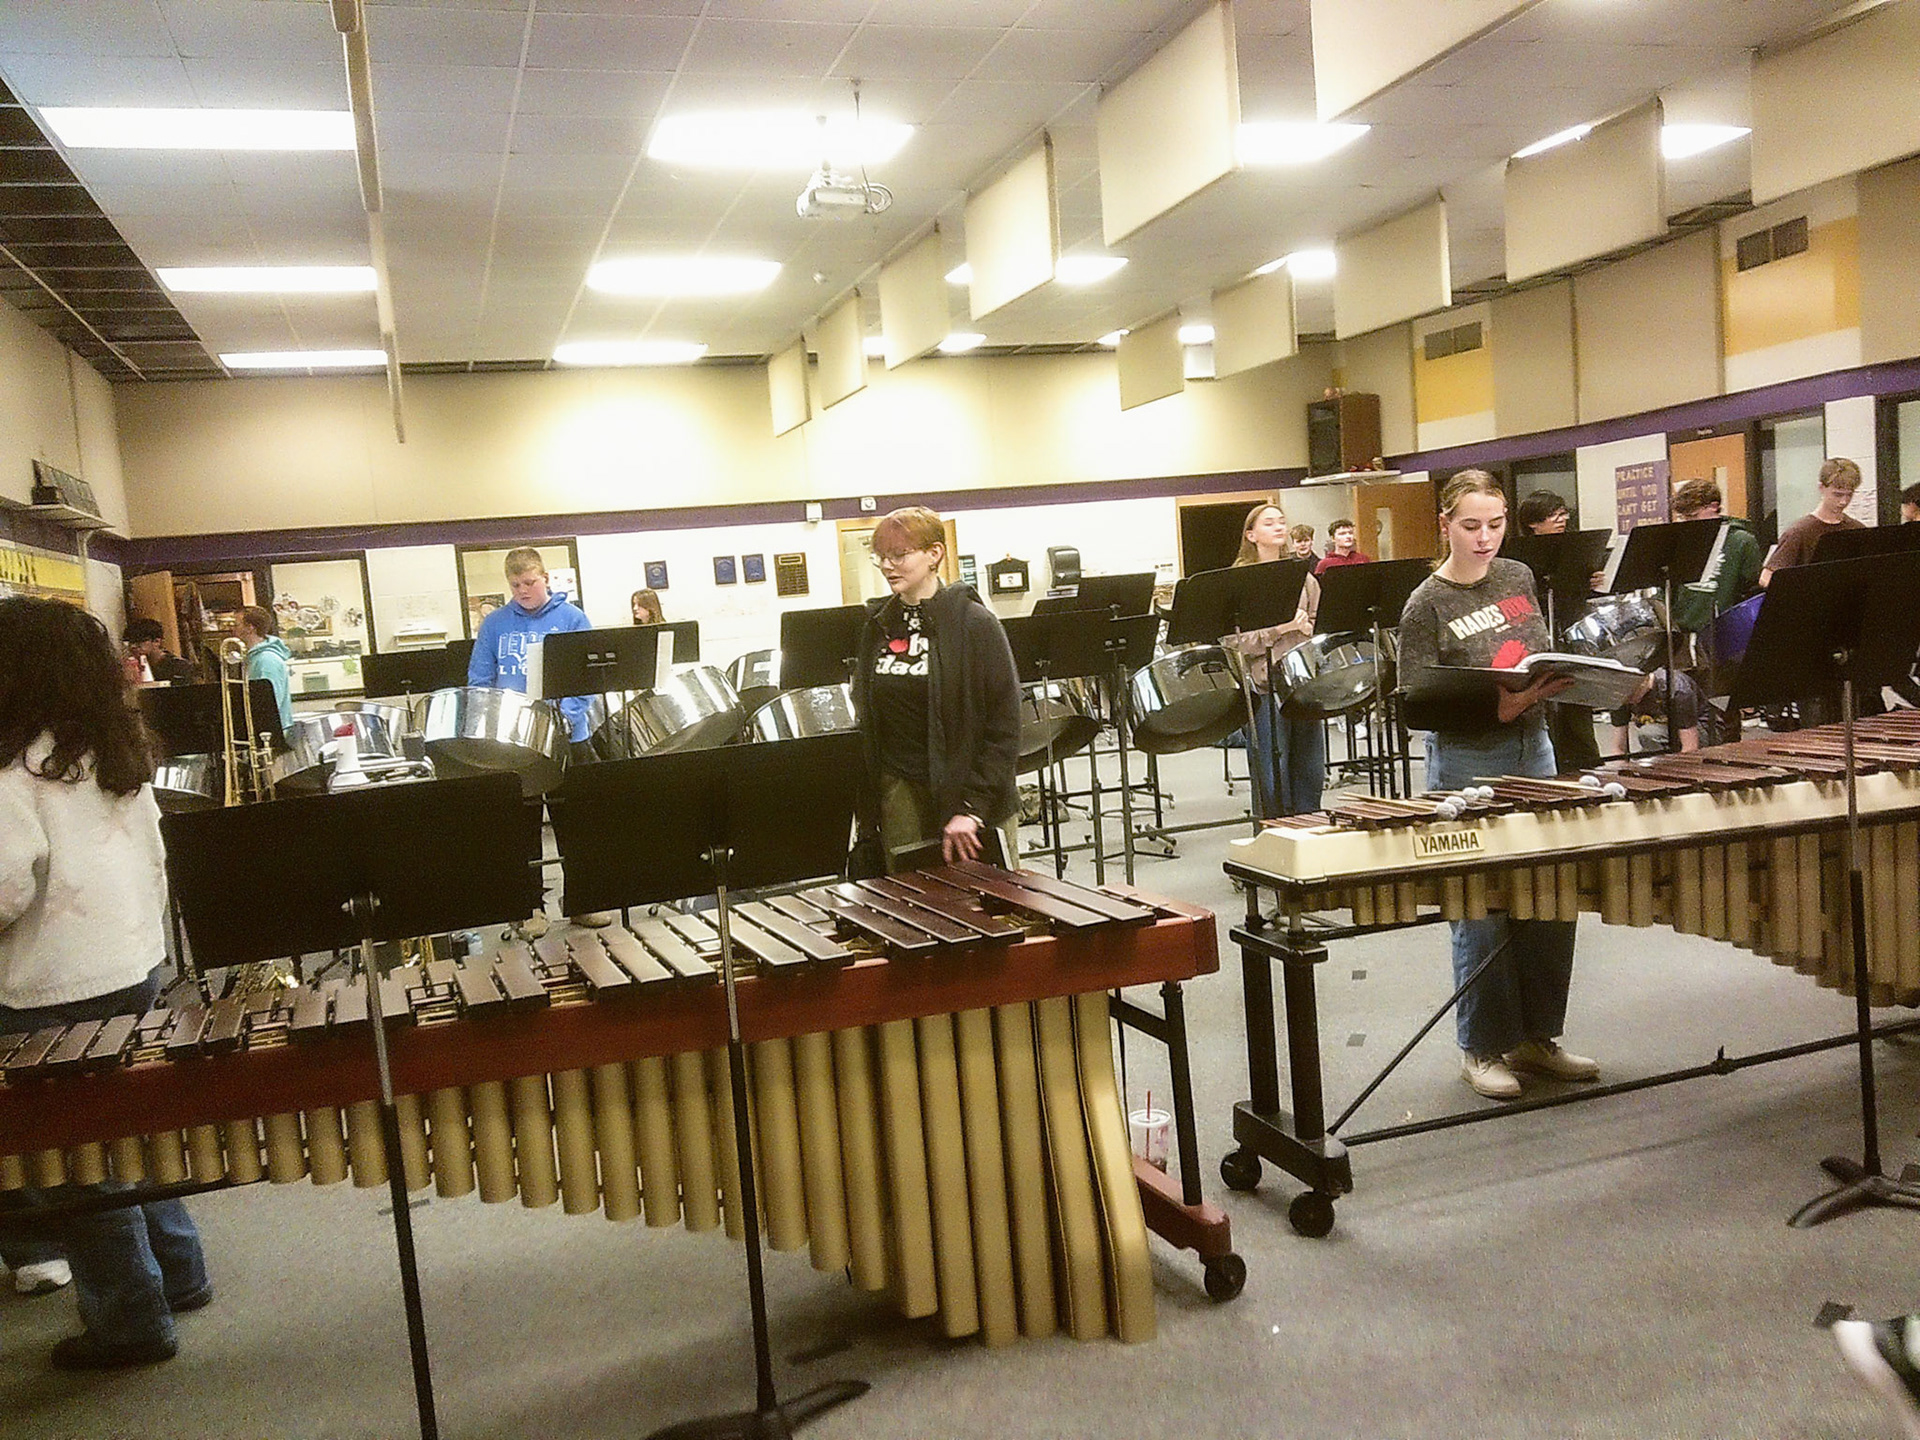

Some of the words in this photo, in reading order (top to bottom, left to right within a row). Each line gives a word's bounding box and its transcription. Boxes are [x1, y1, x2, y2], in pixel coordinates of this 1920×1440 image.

[1616, 466, 1654, 481] PRACTICE
[1641, 500, 1658, 513] GET
[1621, 519, 1630, 531] IT
[1420, 831, 1480, 854] YAMAHA
